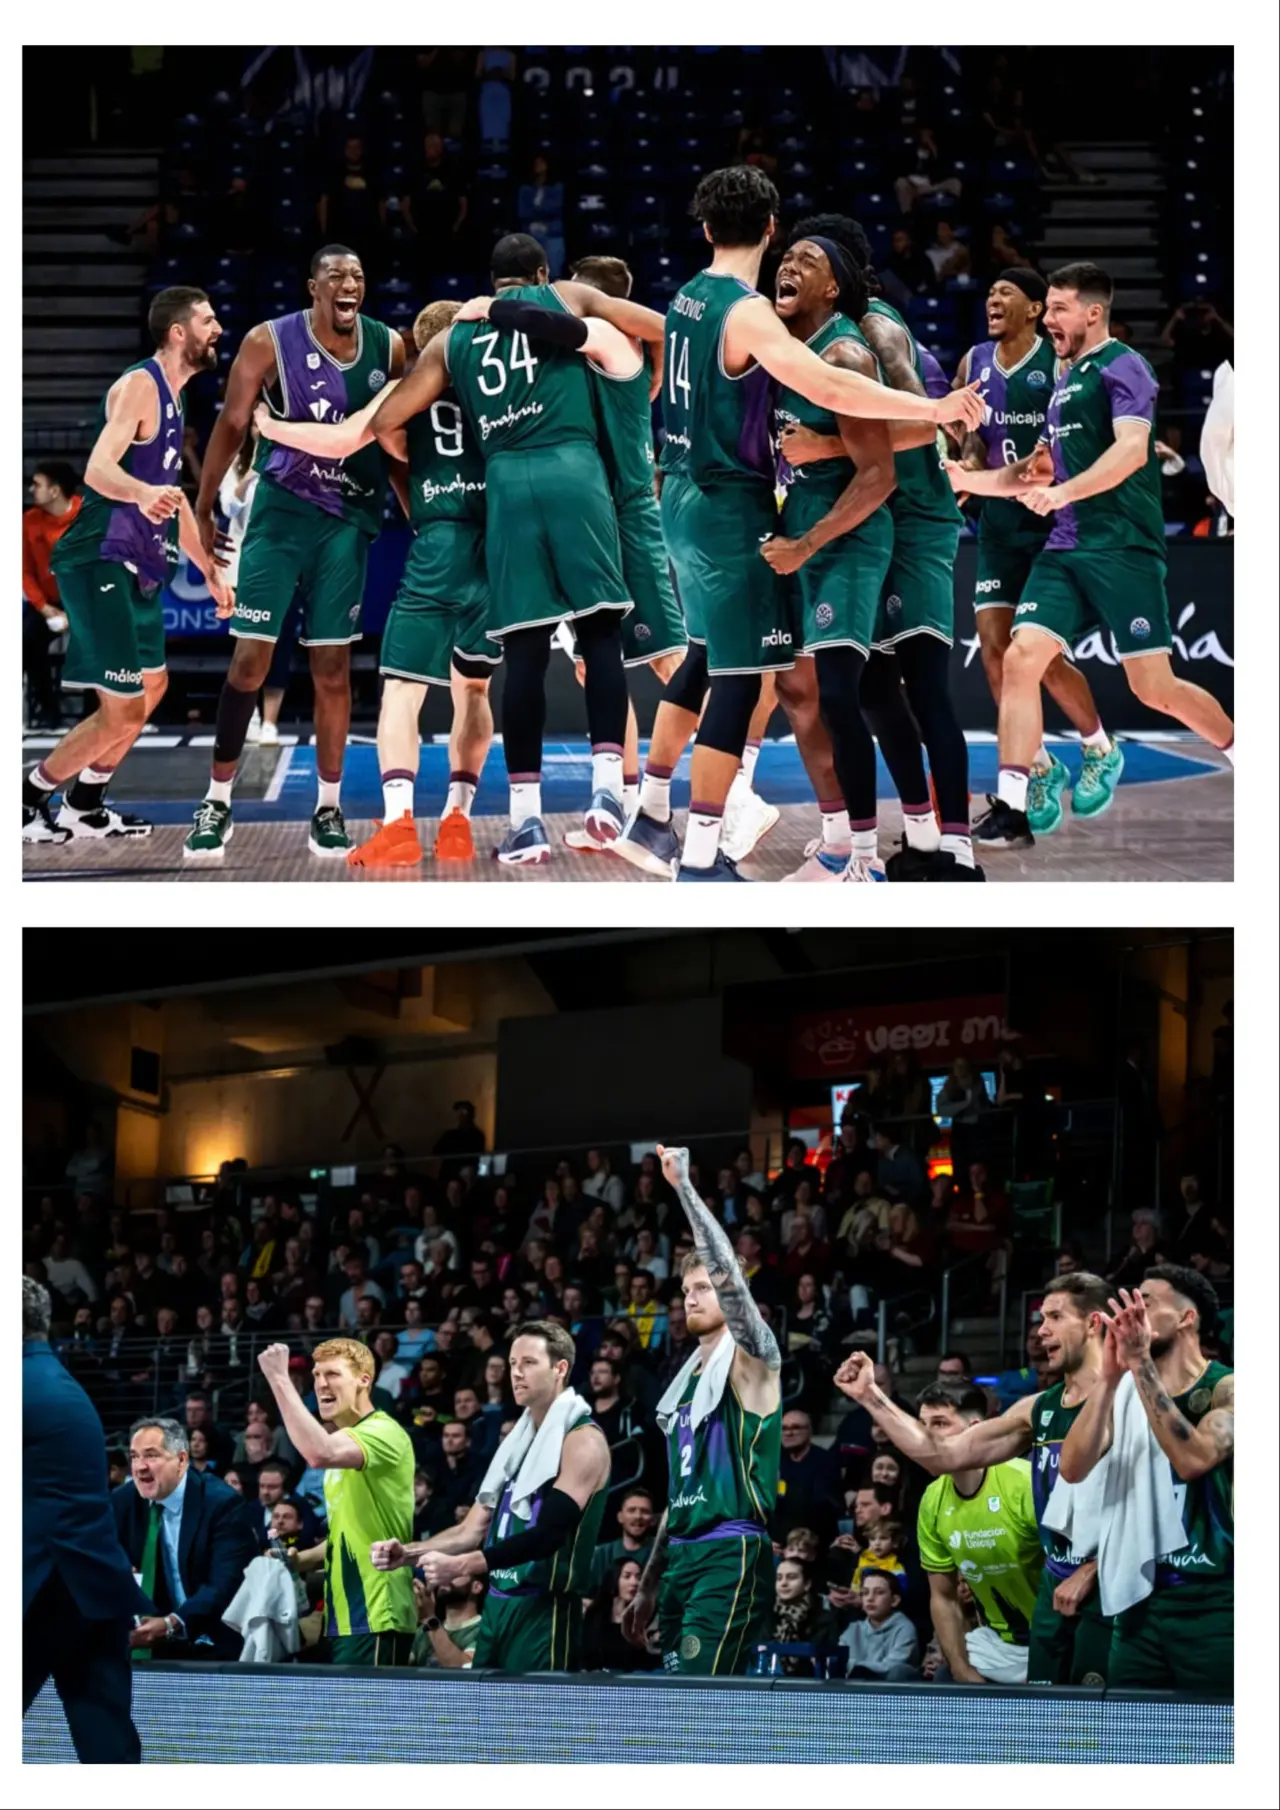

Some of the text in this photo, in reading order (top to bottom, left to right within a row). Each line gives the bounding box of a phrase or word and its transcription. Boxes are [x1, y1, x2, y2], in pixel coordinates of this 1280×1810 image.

[471, 328, 538, 396] 34
[669, 331, 691, 410] 14
[430, 400, 465, 457] 9
[994, 411, 1045, 427] Unicaja
[1002, 438, 1019, 466] 6
[680, 1444, 692, 1477] 2
